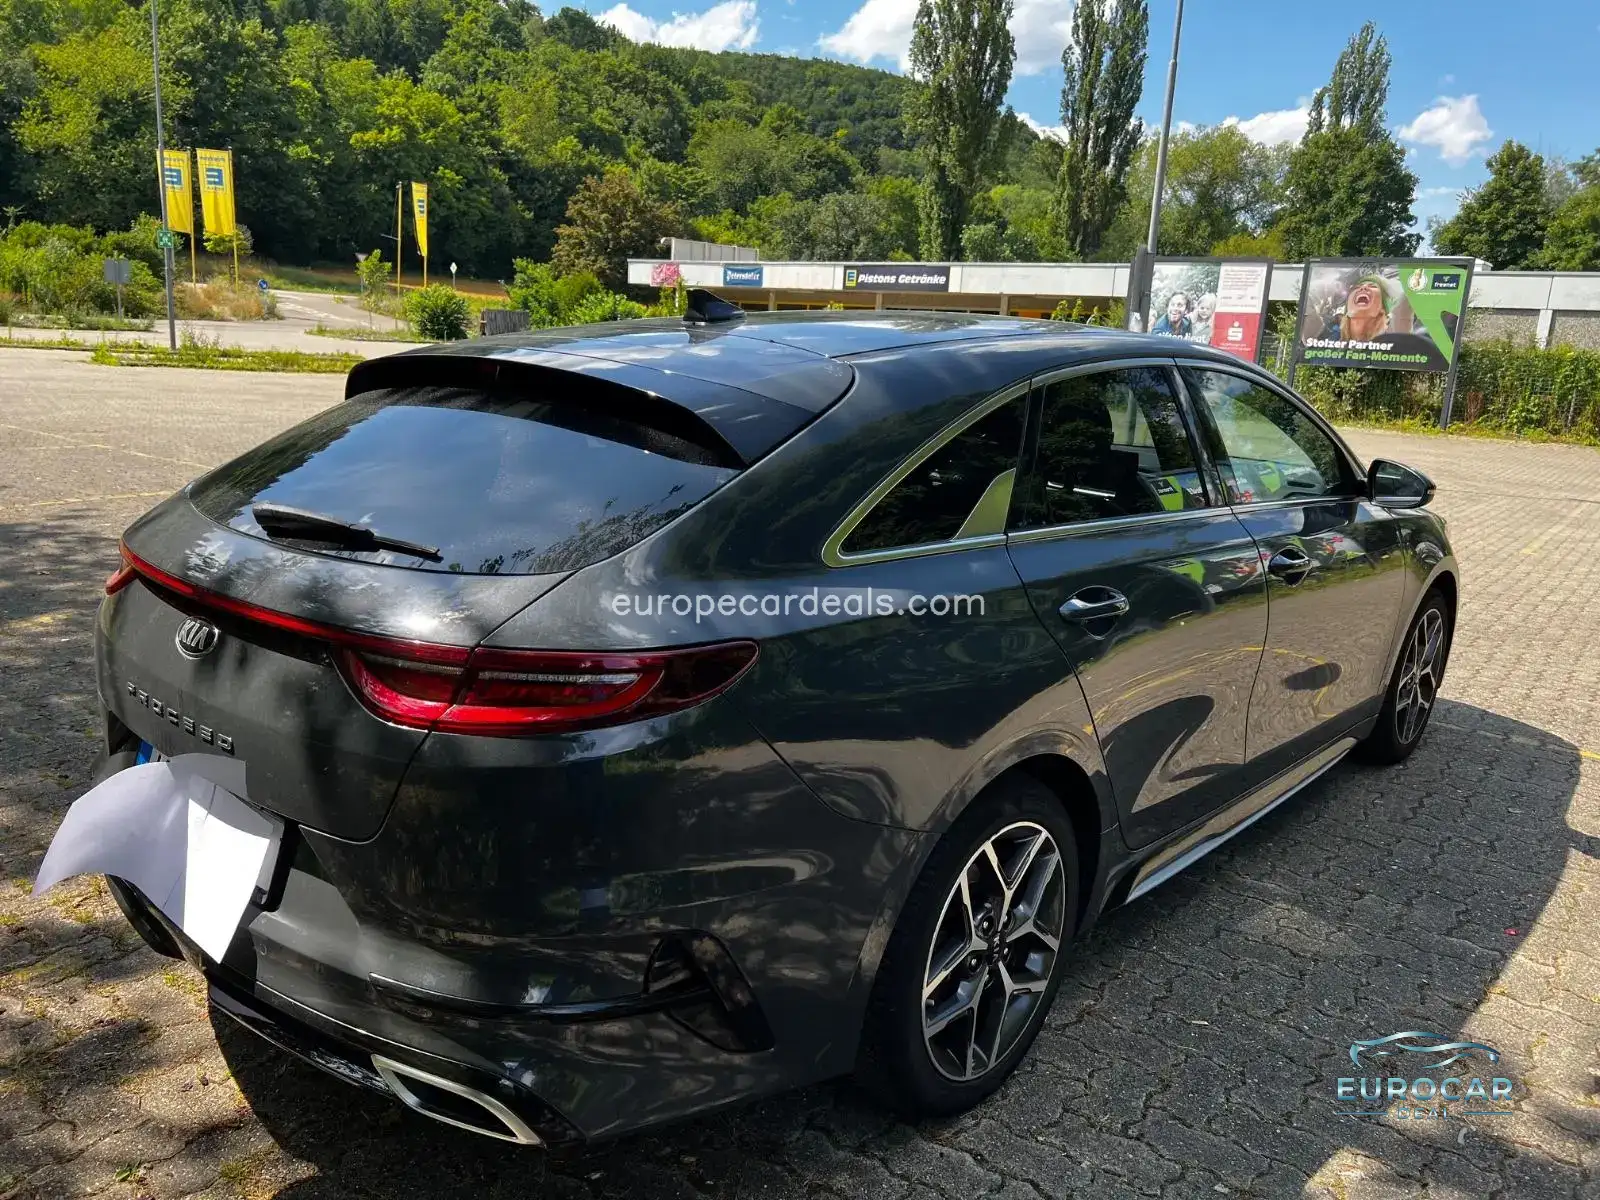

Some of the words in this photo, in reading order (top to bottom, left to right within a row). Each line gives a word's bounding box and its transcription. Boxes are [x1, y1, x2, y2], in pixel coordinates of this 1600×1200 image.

[858, 273, 897, 284] Pistons
[898, 274, 947, 285] Getränke
[1306, 337, 1347, 349] Stolzer
[1348, 340, 1394, 351] Partner
[1304, 349, 1344, 360] großer
[1345, 351, 1428, 364] Fan-Momente
[178, 619, 210, 650] KIA
[127, 681, 234, 753] PROCEED
